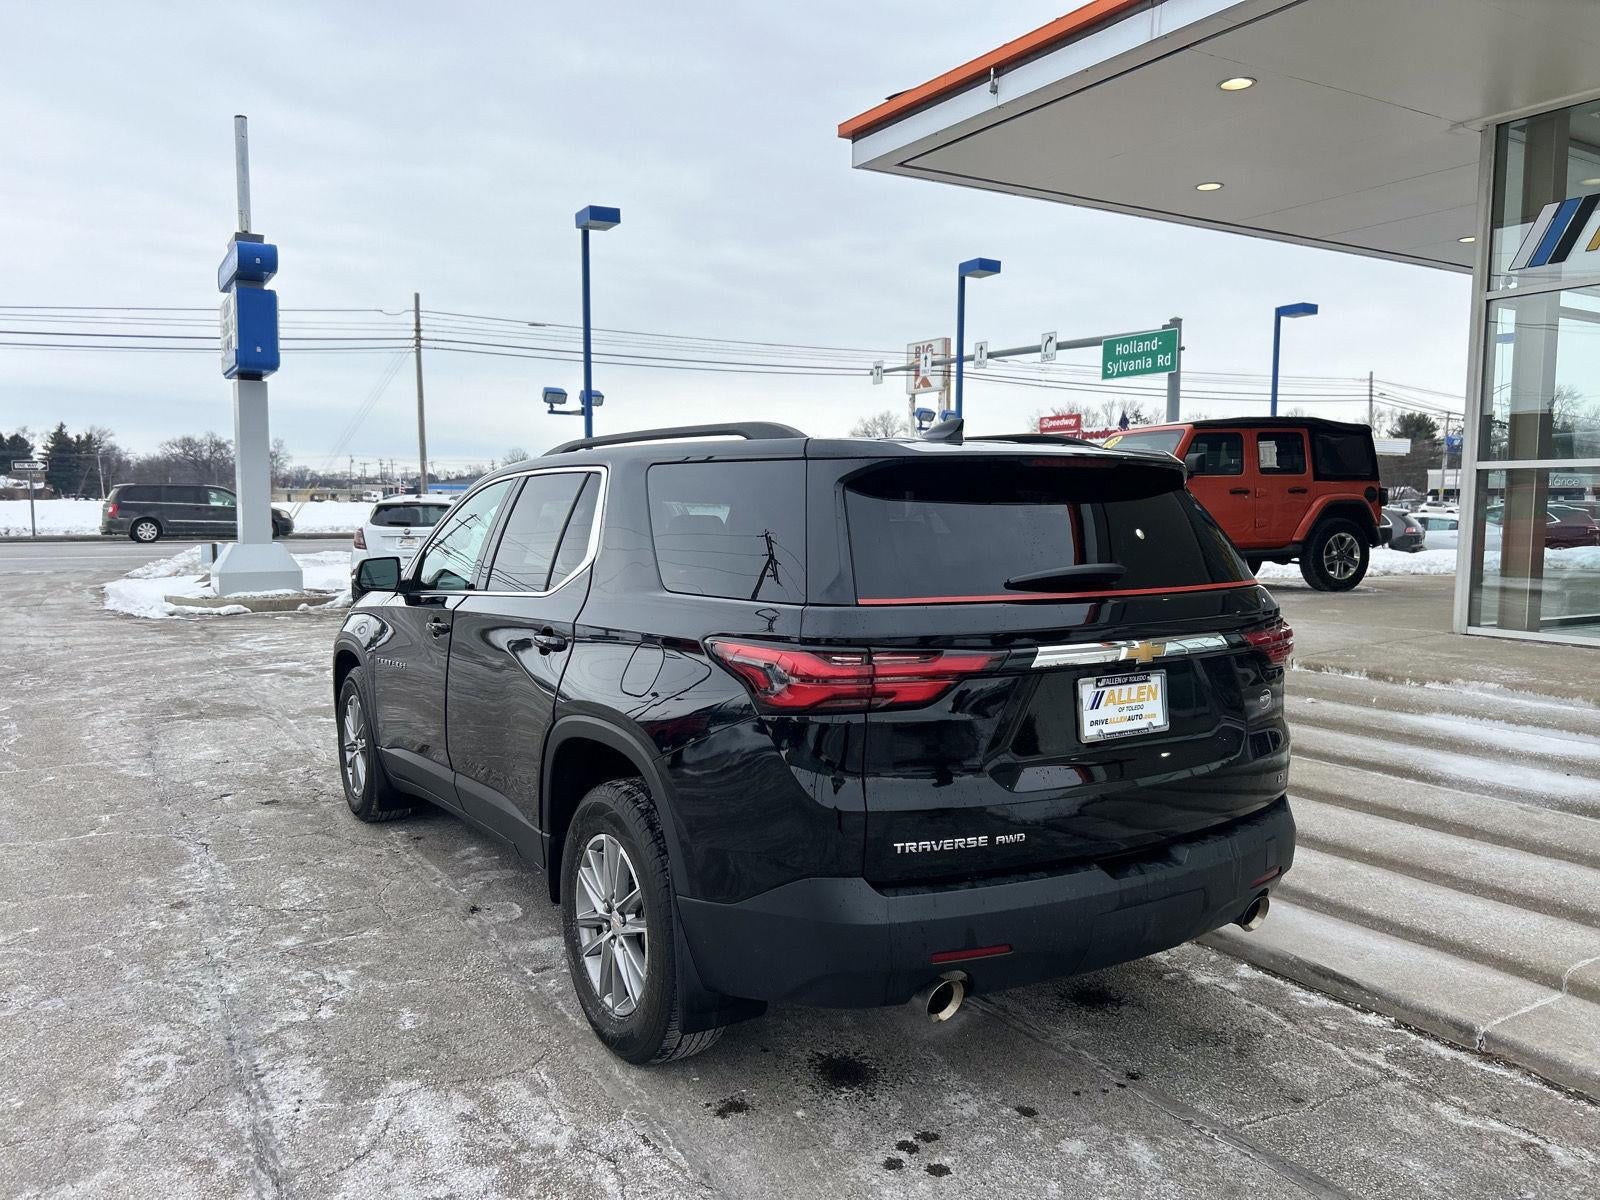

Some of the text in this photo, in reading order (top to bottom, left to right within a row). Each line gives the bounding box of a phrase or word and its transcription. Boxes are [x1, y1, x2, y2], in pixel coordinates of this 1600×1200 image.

[1115, 337, 1162, 355] Holland-
[1107, 352, 1171, 376] Sylvania Rd
[1042, 418, 1077, 428] Speedway
[1104, 684, 1158, 706] ALLEN
[893, 833, 1026, 854] TRAVERSE AWD
